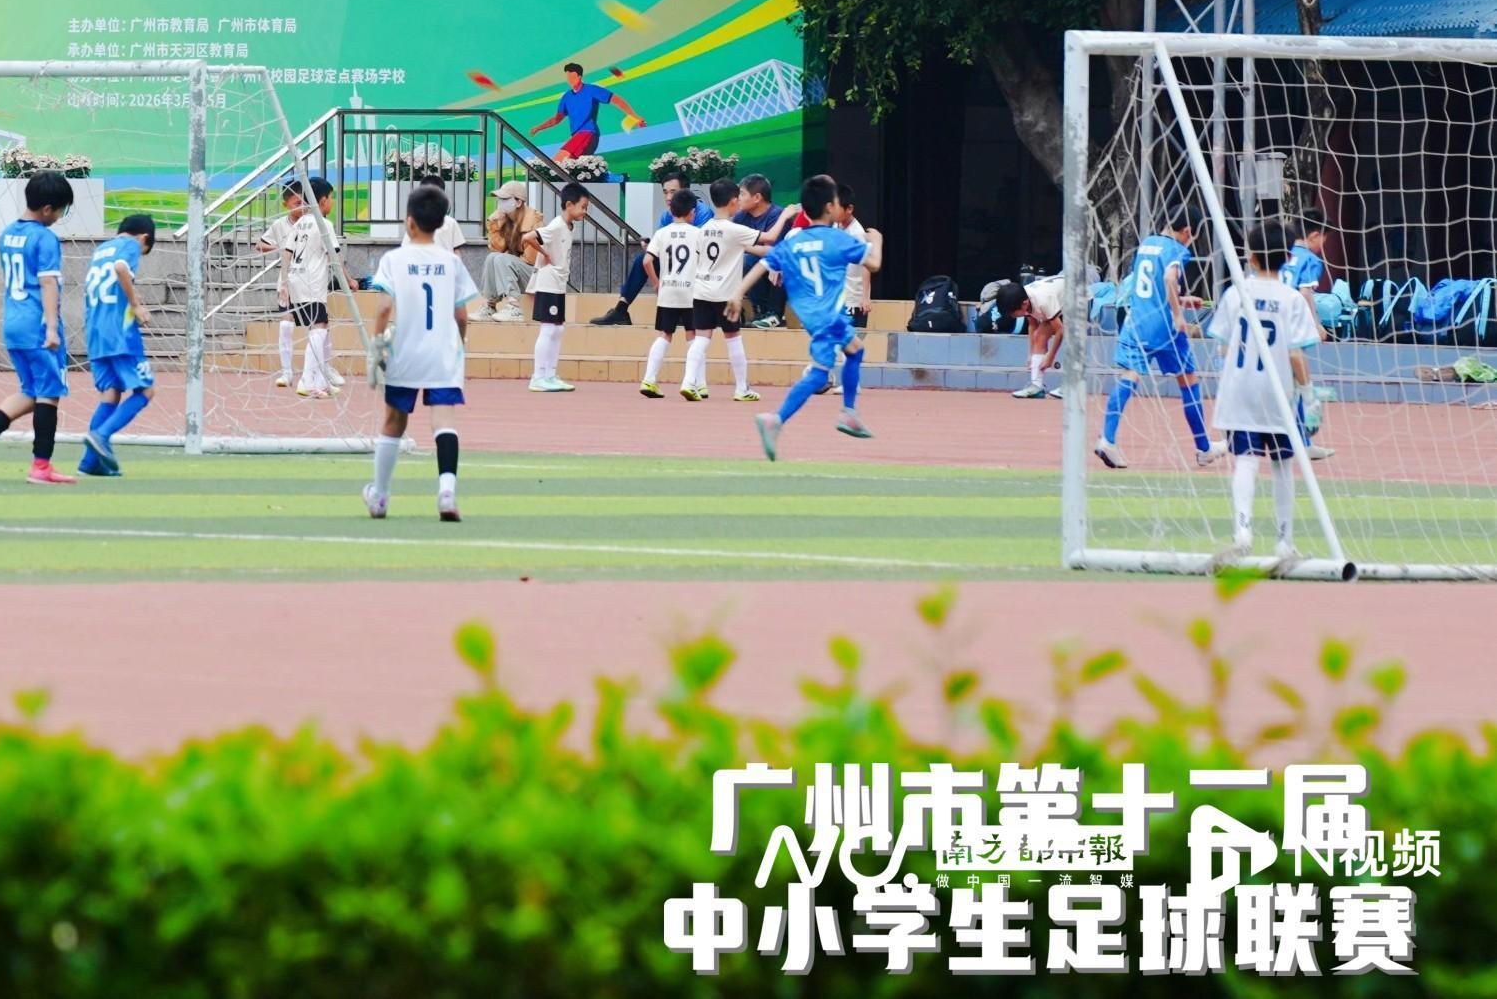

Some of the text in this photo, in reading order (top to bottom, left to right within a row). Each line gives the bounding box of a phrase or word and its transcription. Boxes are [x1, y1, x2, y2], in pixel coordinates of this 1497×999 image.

[217, 17, 297, 34] 广州市体育局
[230, 68, 406, 85] 广州校园足球定点赛场学校
[665, 244, 690, 275] 19
[706, 241, 720, 271] 9
[2, 252, 28, 301] 10
[86, 261, 119, 307] 22
[799, 256, 823, 297] 4
[1135, 259, 1154, 299] 6
[422, 282, 433, 331] 1
